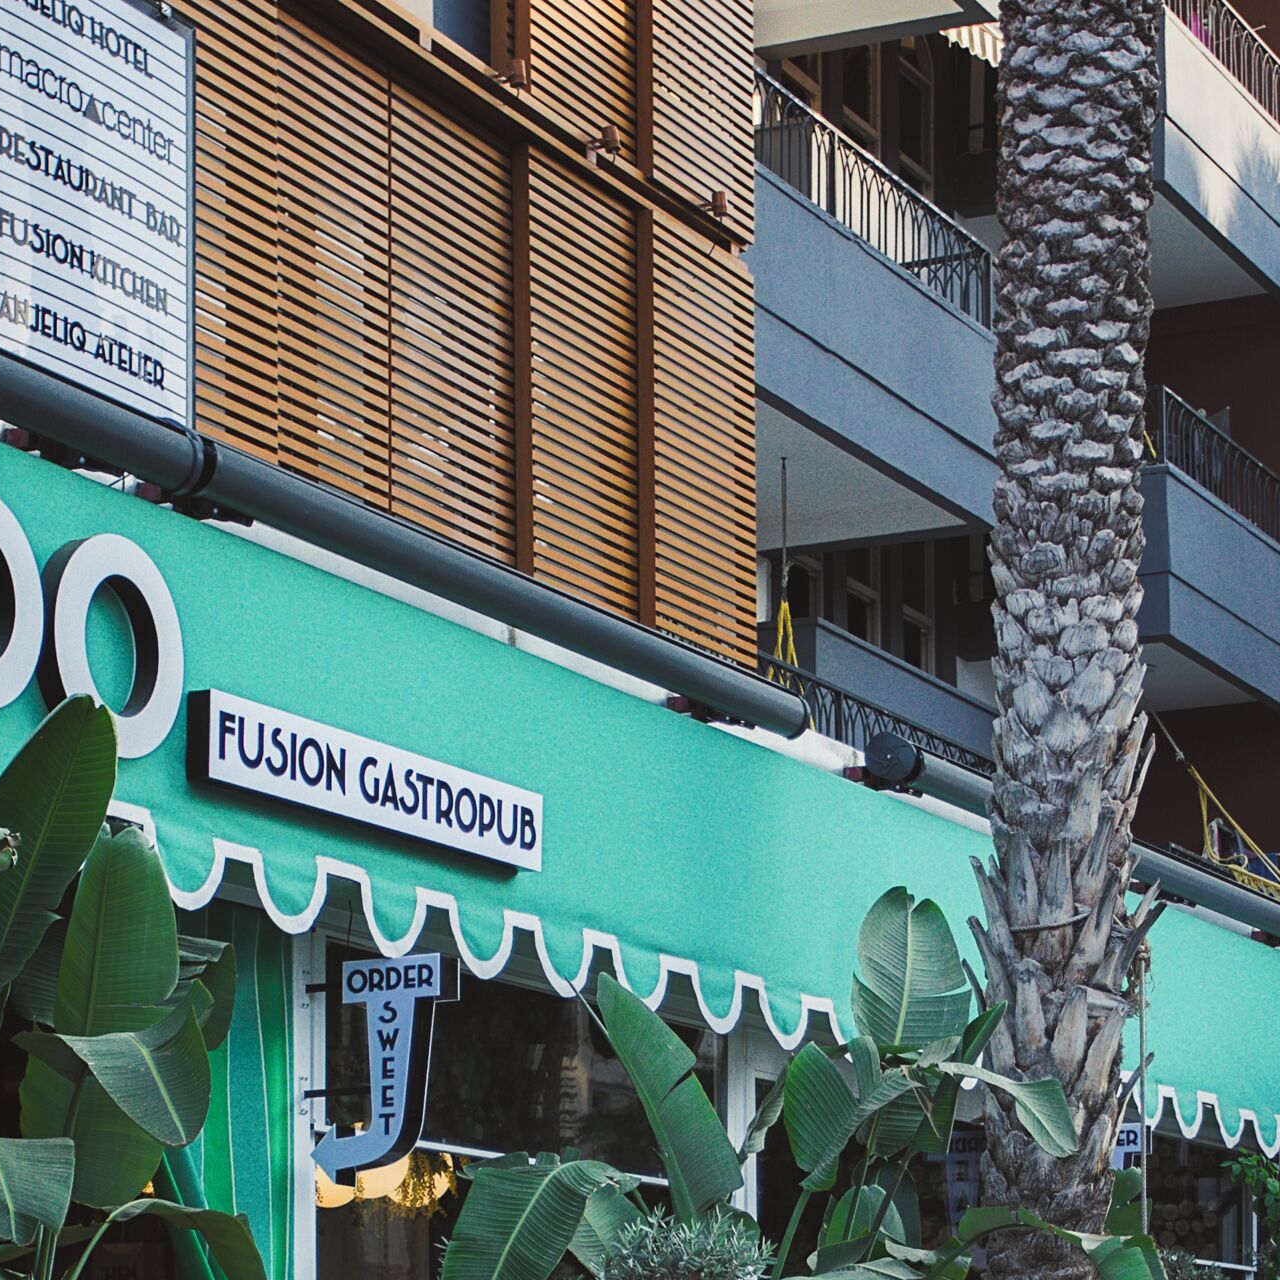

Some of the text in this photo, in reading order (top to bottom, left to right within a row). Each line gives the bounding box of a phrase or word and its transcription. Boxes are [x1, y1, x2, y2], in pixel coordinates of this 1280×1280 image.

[90, 16, 153, 79] HOTEL
[145, 201, 182, 247] BAR
[89, 250, 168, 317] KITCHEN
[94, 332, 165, 391] ATELIER
[218, 710, 538, 851] FUSION GASTROPUB
[346, 963, 434, 994] ORDER
[376, 1000, 400, 1136] SWEET
